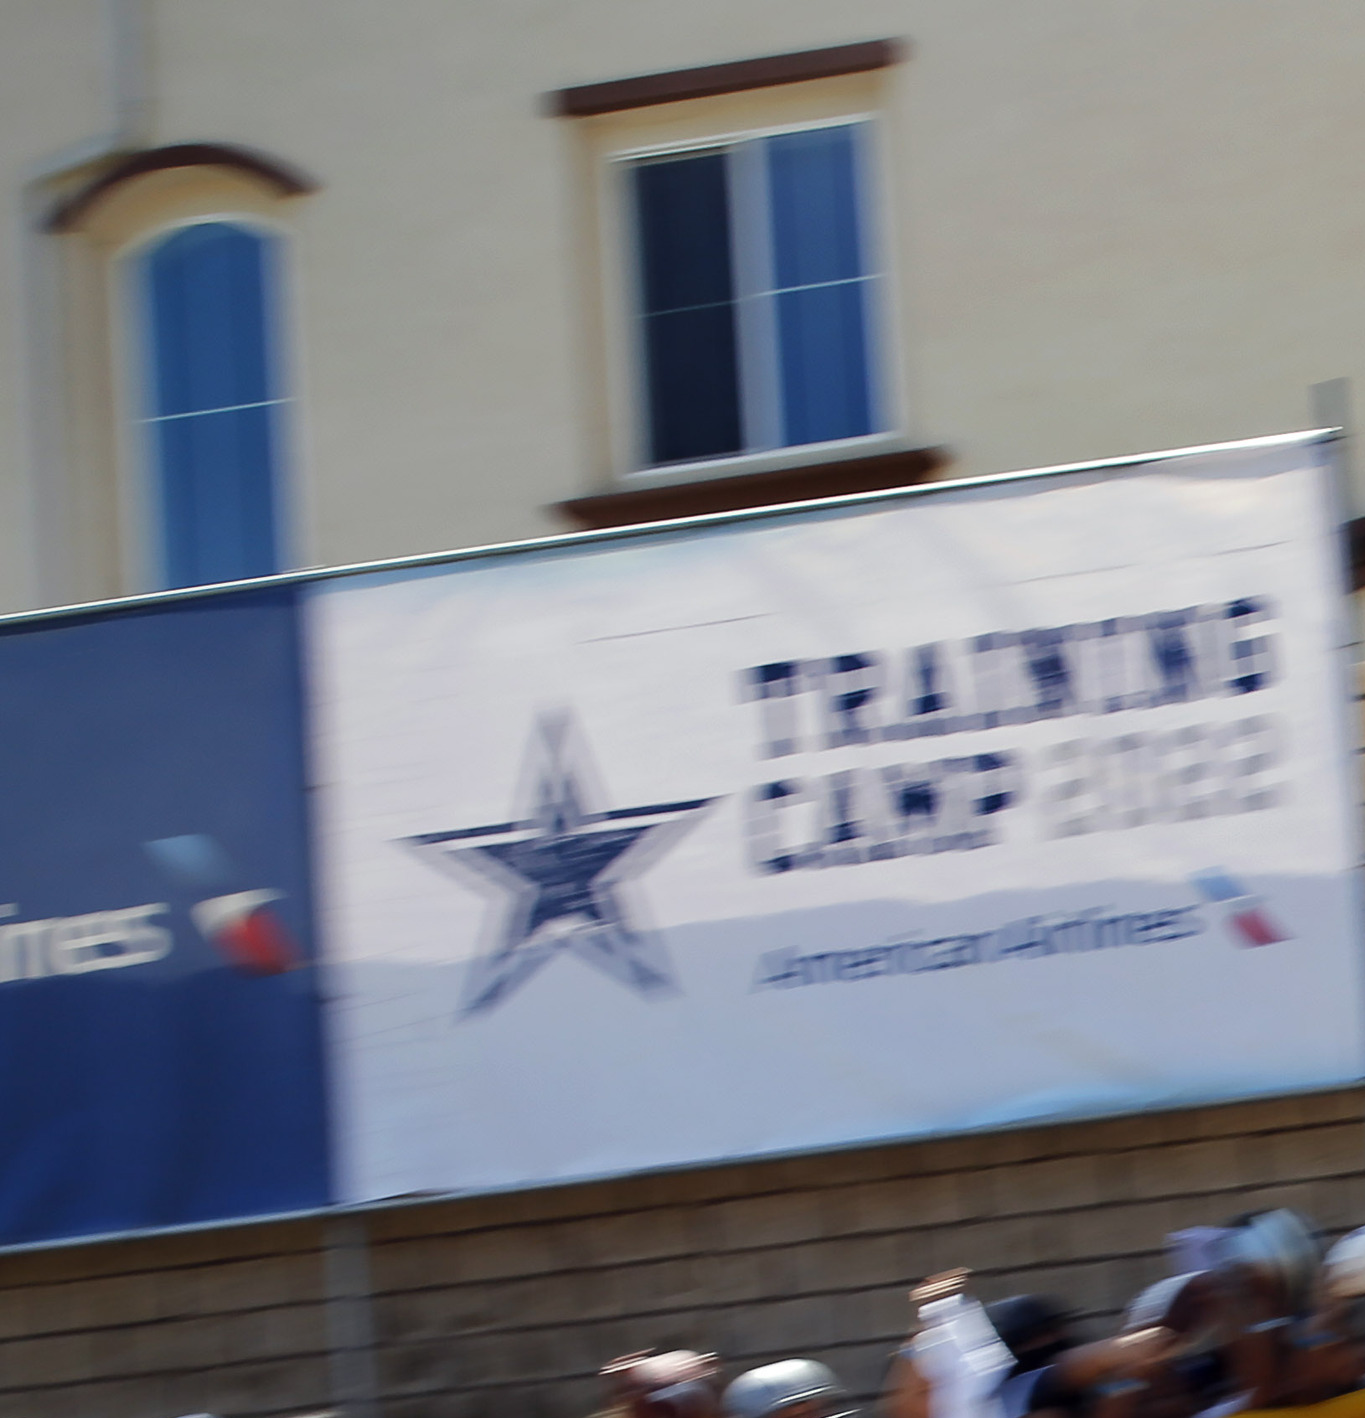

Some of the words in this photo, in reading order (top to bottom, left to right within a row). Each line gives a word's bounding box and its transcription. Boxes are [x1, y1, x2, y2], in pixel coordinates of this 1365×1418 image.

[740, 596, 1280, 762] TRAINING
[744, 748, 1026, 877] CAMP
[1040, 713, 1290, 840] 2022
[748, 929, 1000, 994] American
